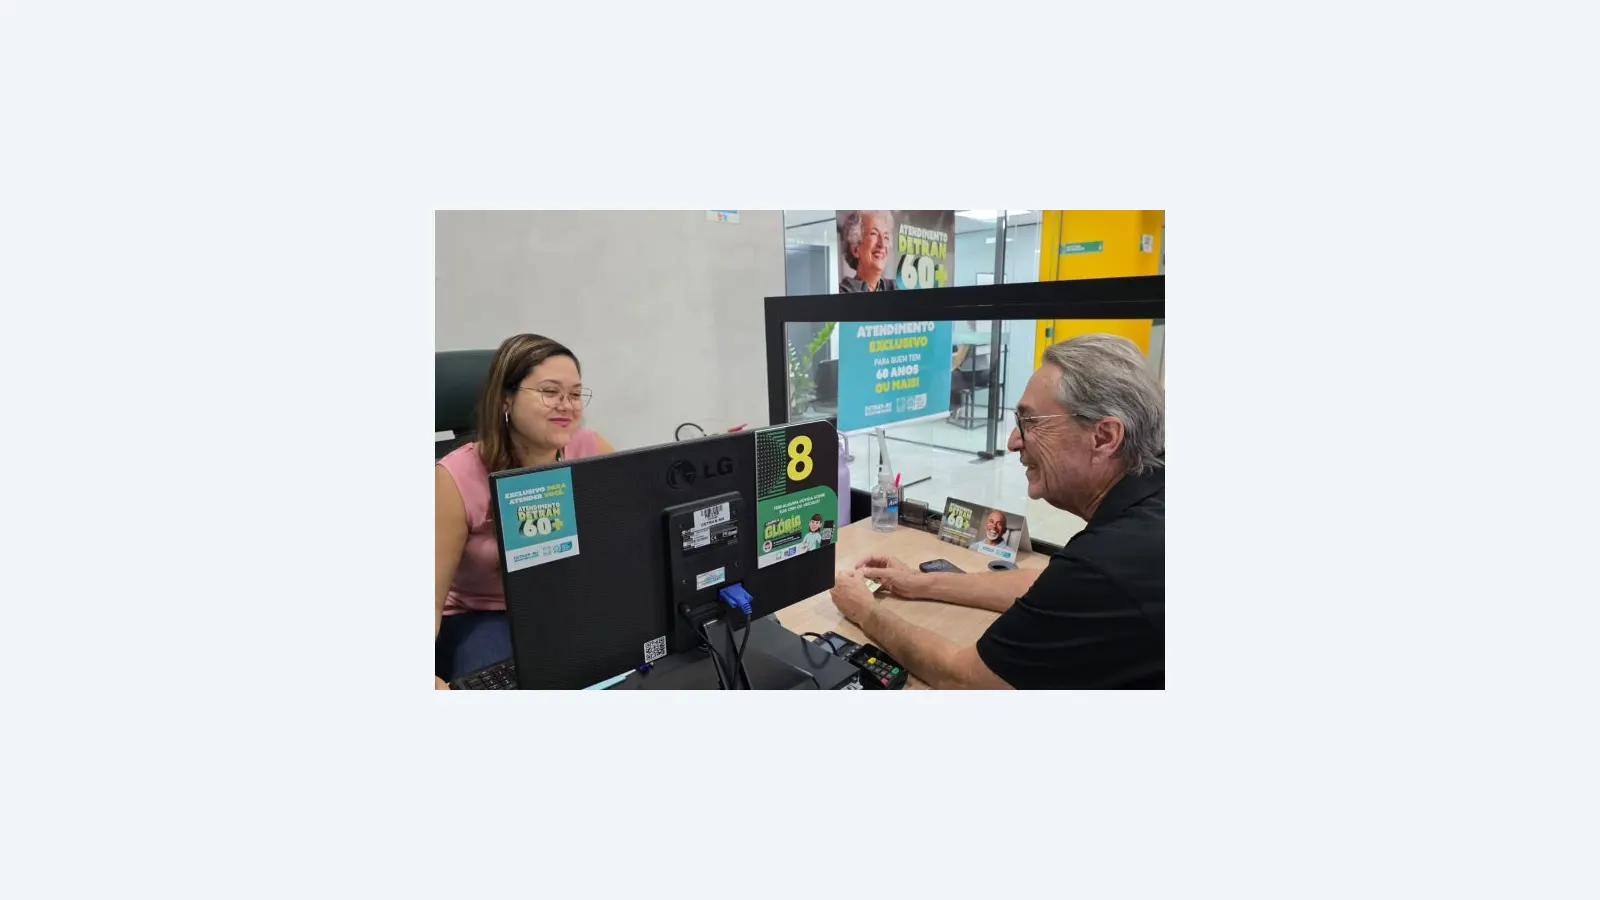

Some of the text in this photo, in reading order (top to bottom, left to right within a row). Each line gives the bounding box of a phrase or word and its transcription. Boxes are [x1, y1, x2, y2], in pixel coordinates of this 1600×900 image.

[899, 224, 947, 243] ATENDIMENTO
[899, 235, 947, 259] DETRAN
[899, 254, 947, 290] 60+
[857, 321, 935, 338] ATENDIMENTO
[869, 336, 928, 353] EXCLUSIVO
[874, 354, 921, 367] PARA QUEM TEM
[876, 364, 919, 379] 60 ANOS
[875, 381, 890, 394] OU
[787, 435, 813, 481] 8
[703, 457, 733, 479] LG
[504, 486, 546, 499] EXCLUSIVO
[509, 494, 543, 505] ATENDER
[518, 502, 560, 512] ATENDIMENTO
[519, 507, 560, 522] DETRAN
[522, 518, 563, 537] 60+
[947, 513, 970, 531] 60+
